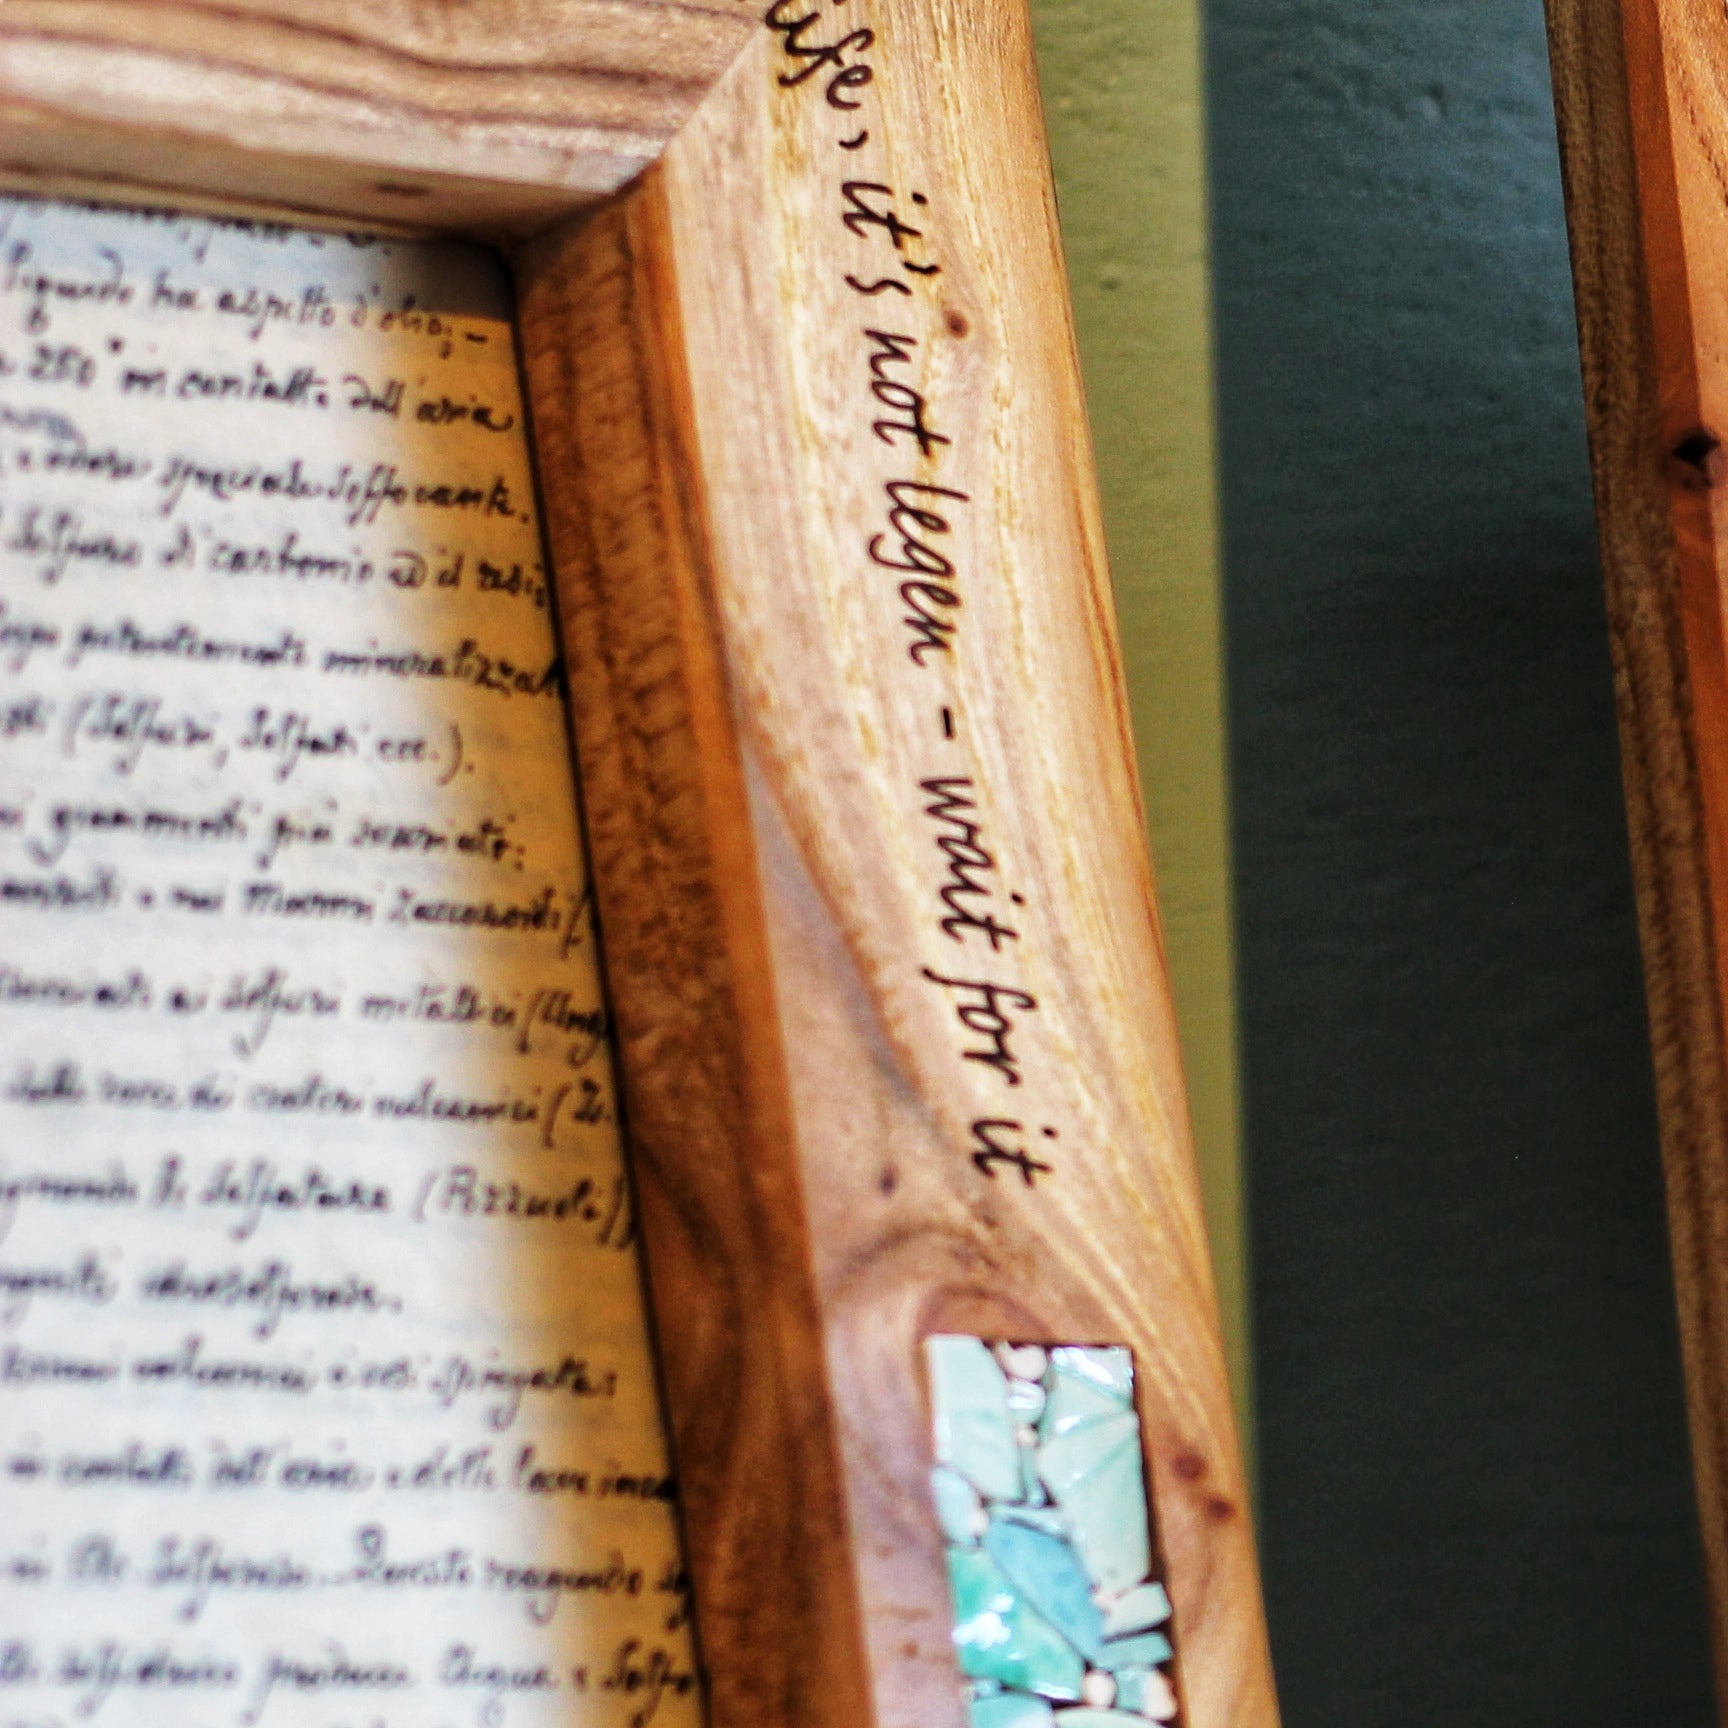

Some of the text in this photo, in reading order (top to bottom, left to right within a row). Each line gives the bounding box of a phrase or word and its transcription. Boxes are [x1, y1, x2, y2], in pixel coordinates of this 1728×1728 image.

[841, 180, 941, 296] it's
[865, 328, 951, 458] not
[867, 480, 971, 669] legen
[919, 777, 1026, 953] wait
[922, 965, 1037, 1087] for
[969, 1117, 1058, 1187] it
